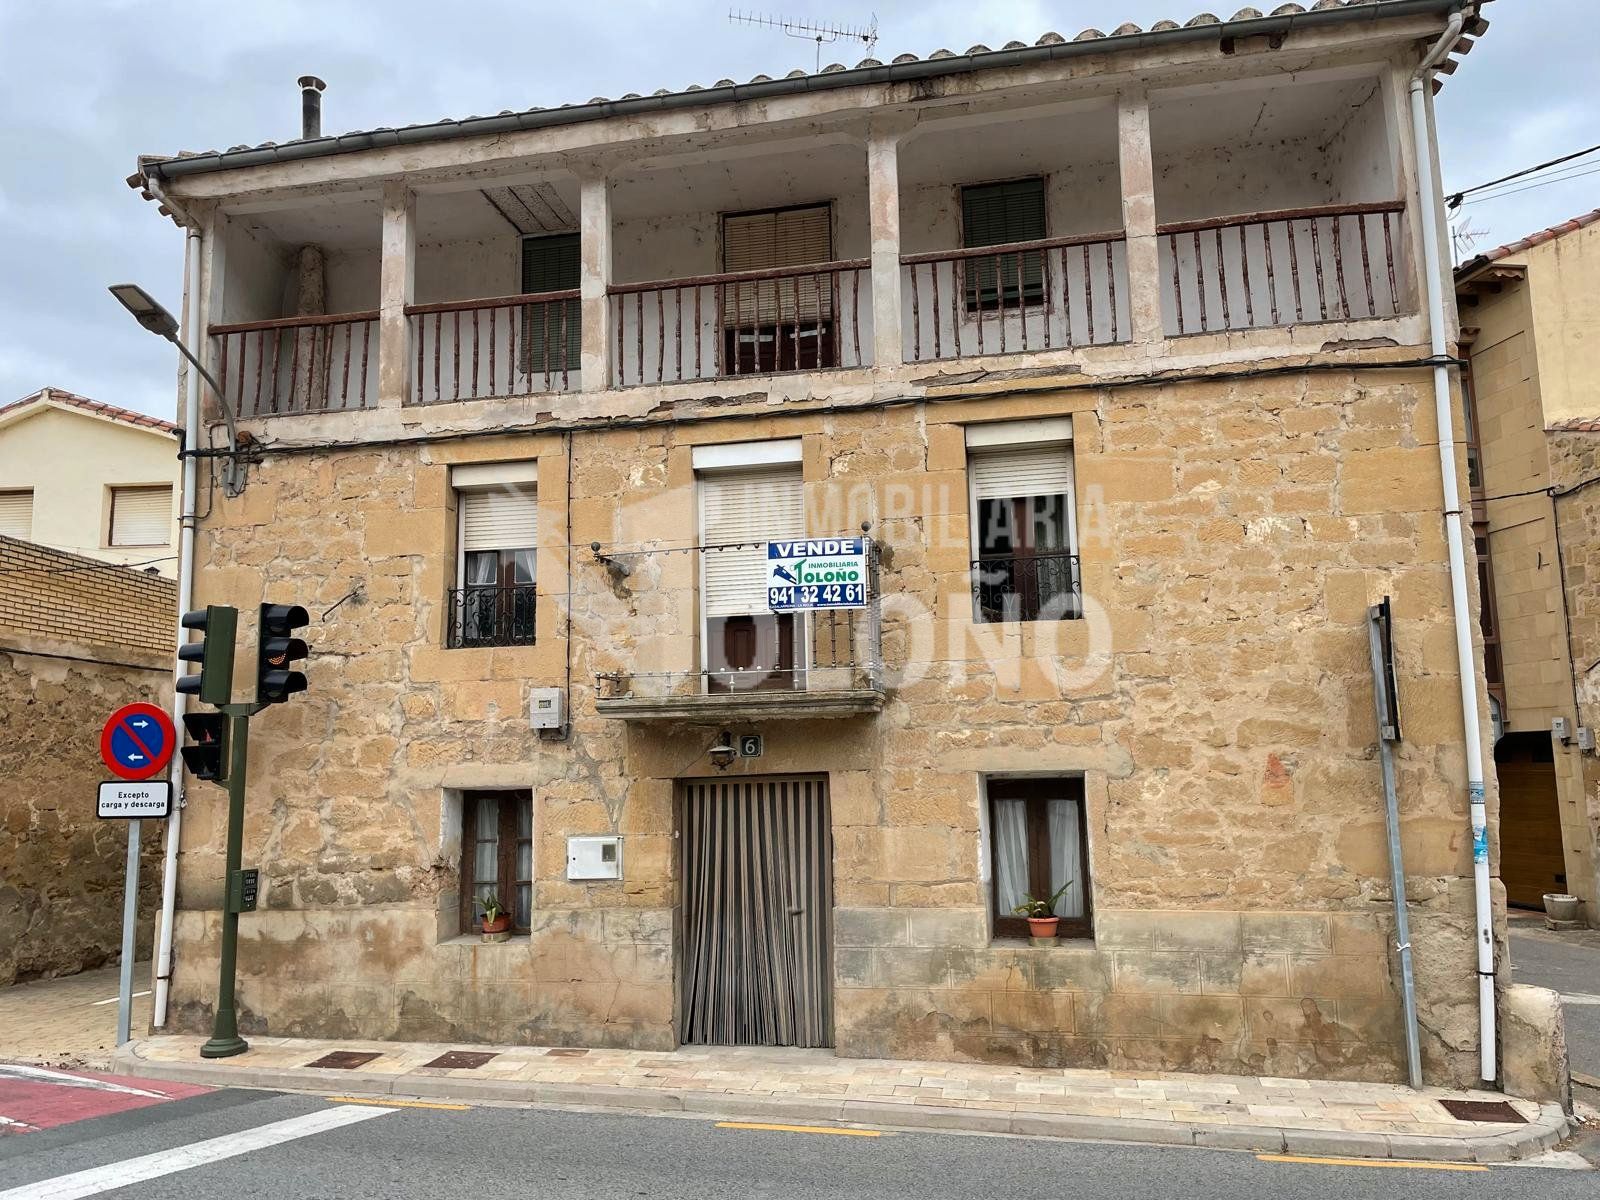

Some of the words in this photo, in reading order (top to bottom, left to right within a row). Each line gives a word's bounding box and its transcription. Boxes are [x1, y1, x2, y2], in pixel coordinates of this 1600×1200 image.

[776, 541, 854, 558] VENDE
[794, 558, 859, 585] TOLOÑO
[808, 561, 859, 569] INMOBILIARIA
[770, 587, 795, 605] 941
[800, 586, 819, 603] 32
[822, 584, 842, 602] 42
[845, 583, 863, 601] 61
[745, 739, 755, 754] 6
[118, 791, 149, 799] Excepto
